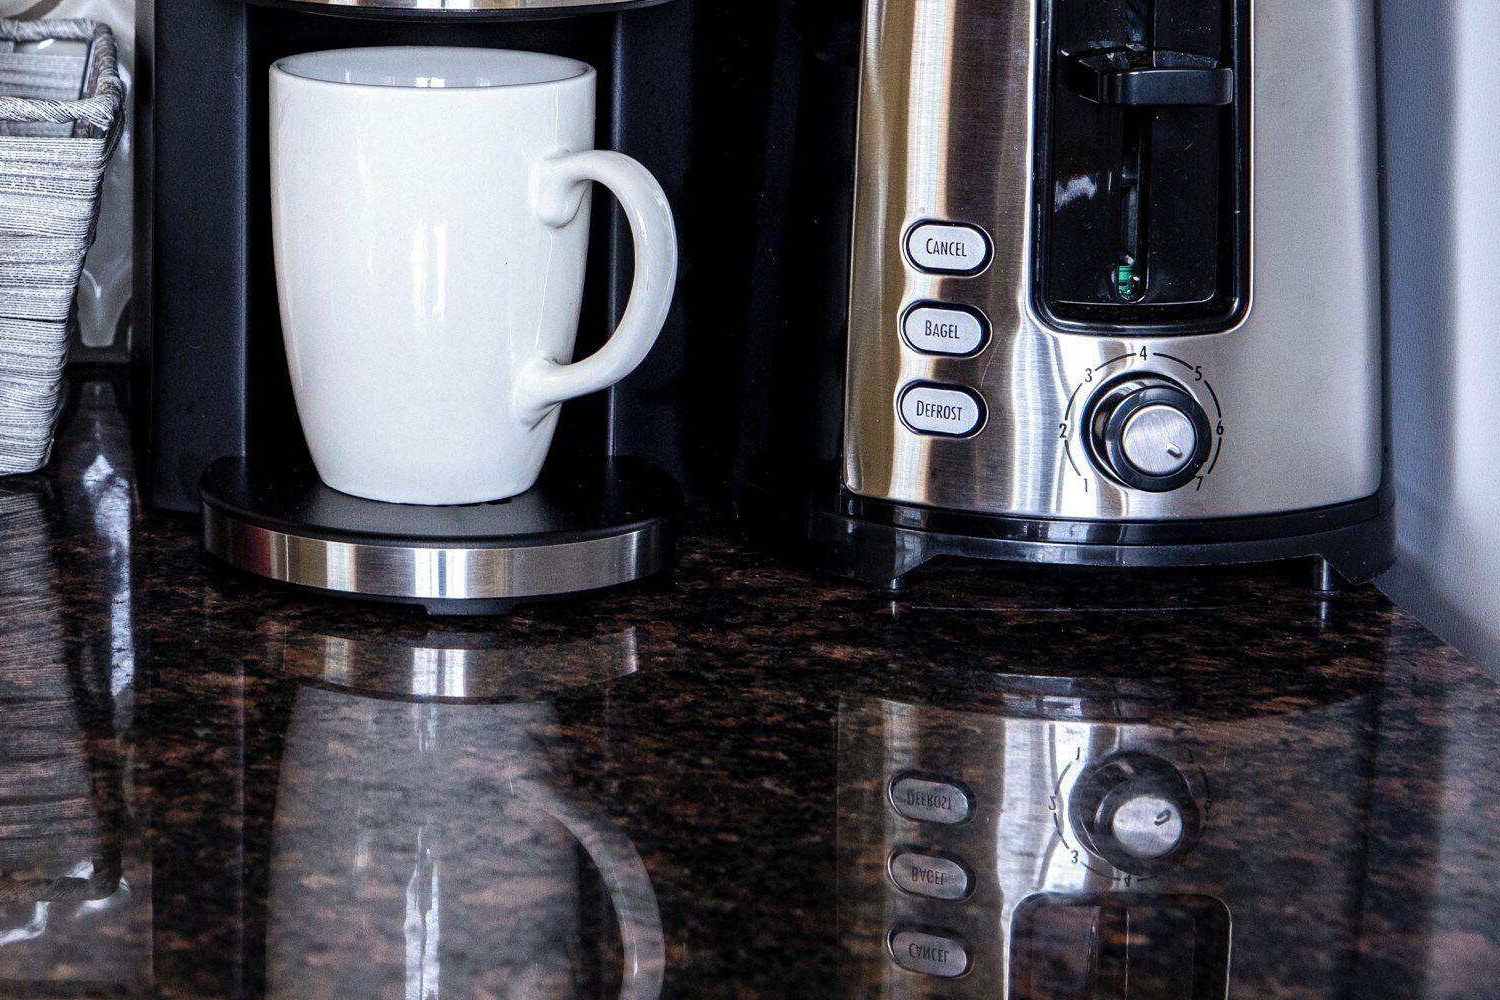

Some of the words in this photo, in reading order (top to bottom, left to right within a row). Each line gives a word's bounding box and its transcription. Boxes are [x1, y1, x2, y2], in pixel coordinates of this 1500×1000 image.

[1139, 345, 1148, 360] 4
[1084, 368, 1092, 382] 3
[1195, 366, 1202, 381] 5
[1059, 423, 1067, 438] 2
[1217, 420, 1223, 435] 6
[1083, 478, 1088, 492] 1
[1196, 475, 1204, 491] 7
